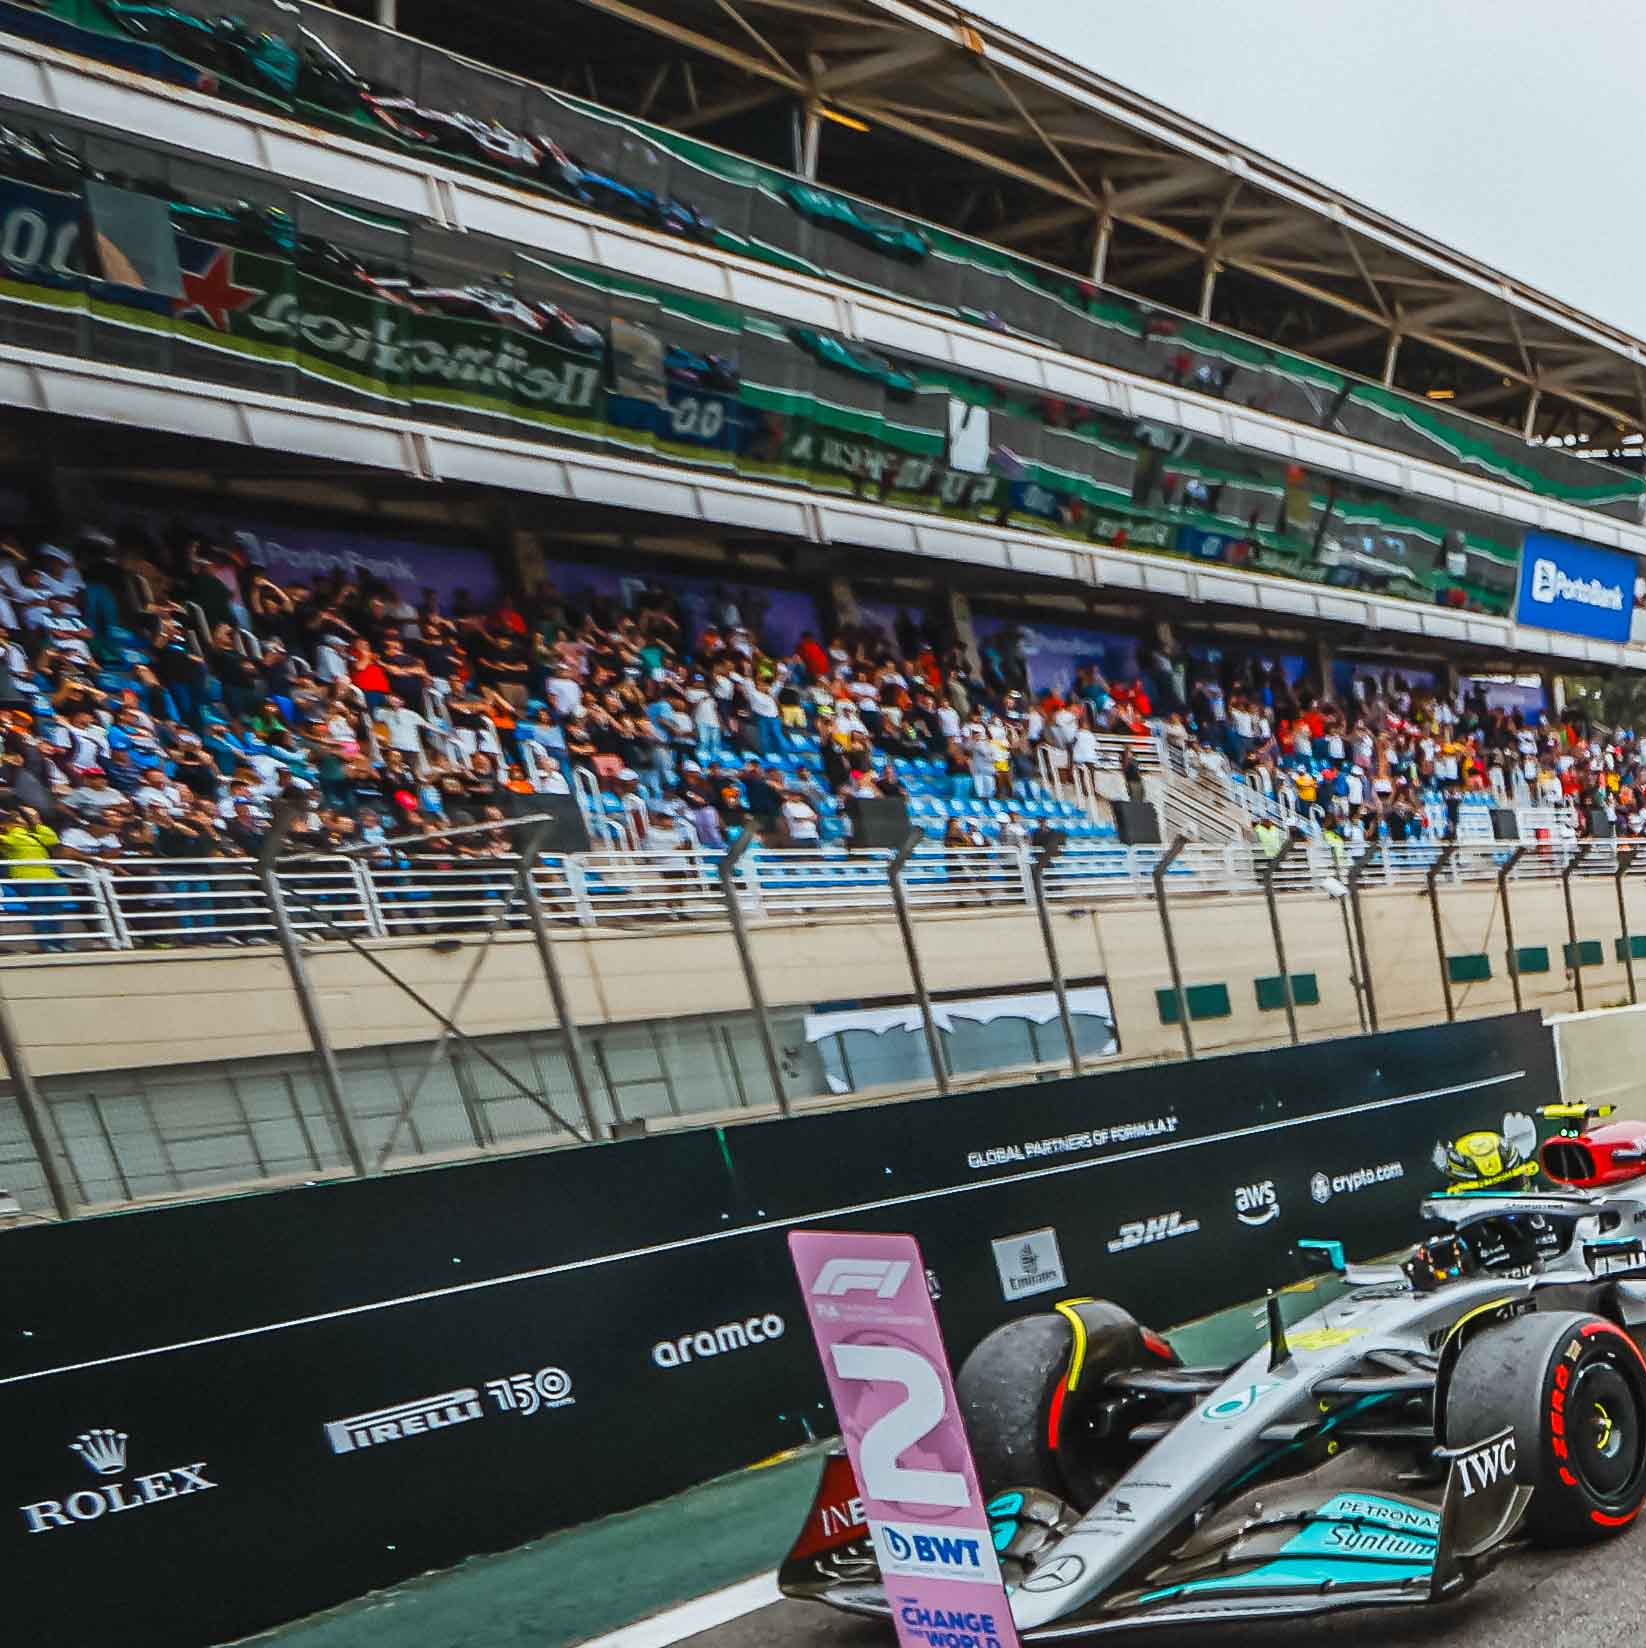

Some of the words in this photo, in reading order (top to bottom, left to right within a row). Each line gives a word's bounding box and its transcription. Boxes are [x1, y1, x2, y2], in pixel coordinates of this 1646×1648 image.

[1235, 1180, 1277, 1212] aws
[1333, 1161, 1404, 1192] crypto.com
[1116, 1211, 1190, 1252] DHL
[1009, 1268, 1057, 1291] Emirates
[651, 1312, 785, 1368] aramco
[323, 1387, 485, 1454] PIRELLI
[831, 1343, 973, 1508] 2
[1456, 1437, 1517, 1497] IWC
[19, 1462, 219, 1533] ROLEX
[822, 1497, 867, 1536] INE
[912, 1535, 980, 1567] BWT
[1325, 1526, 1437, 1557] Syntium
[901, 1607, 997, 1635] CHANGE
